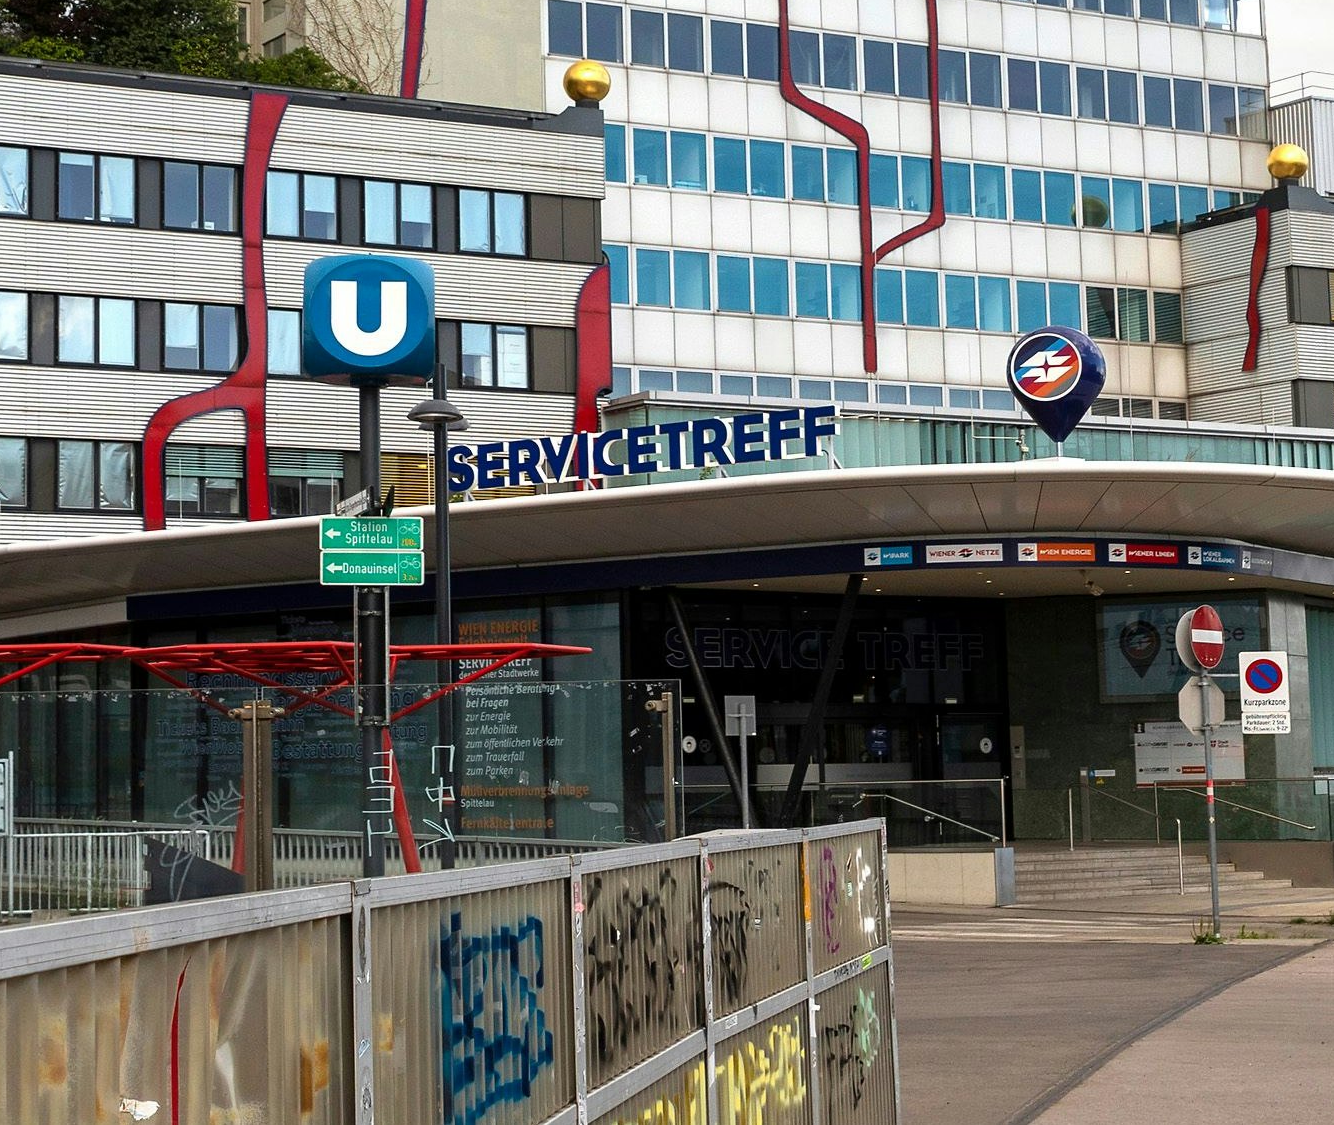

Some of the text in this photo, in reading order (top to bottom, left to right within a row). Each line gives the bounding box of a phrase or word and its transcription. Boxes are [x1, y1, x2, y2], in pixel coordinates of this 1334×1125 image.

[331, 280, 407, 356] U
[447, 405, 840, 493] SERVICETREFF
[351, 521, 387, 532] Station
[345, 534, 393, 546] Spittelau
[929, 548, 1000, 558] WIENER NETZE
[1039, 548, 1092, 557] WIEN ENERGIE
[1128, 550, 1175, 558] WIENER LINIEN
[342, 562, 397, 574] Donauinsel
[458, 619, 538, 636] WIEN ENERGIE
[665, 626, 984, 671] SERVICE TREFF
[498, 668, 539, 678] Stadtwerke
[465, 698, 509, 709] bei Fragen
[1244, 698, 1287, 707] Kurzparkzone
[465, 711, 511, 723] zur Energie
[465, 724, 518, 735] zur Mobilität
[484, 738, 531, 750] öffentlichen
[532, 736, 564, 747] Verkehr
[465, 751, 525, 763] zum Trauerfall
[466, 765, 514, 776] zum Parken
[460, 799, 495, 809] Spittelau
